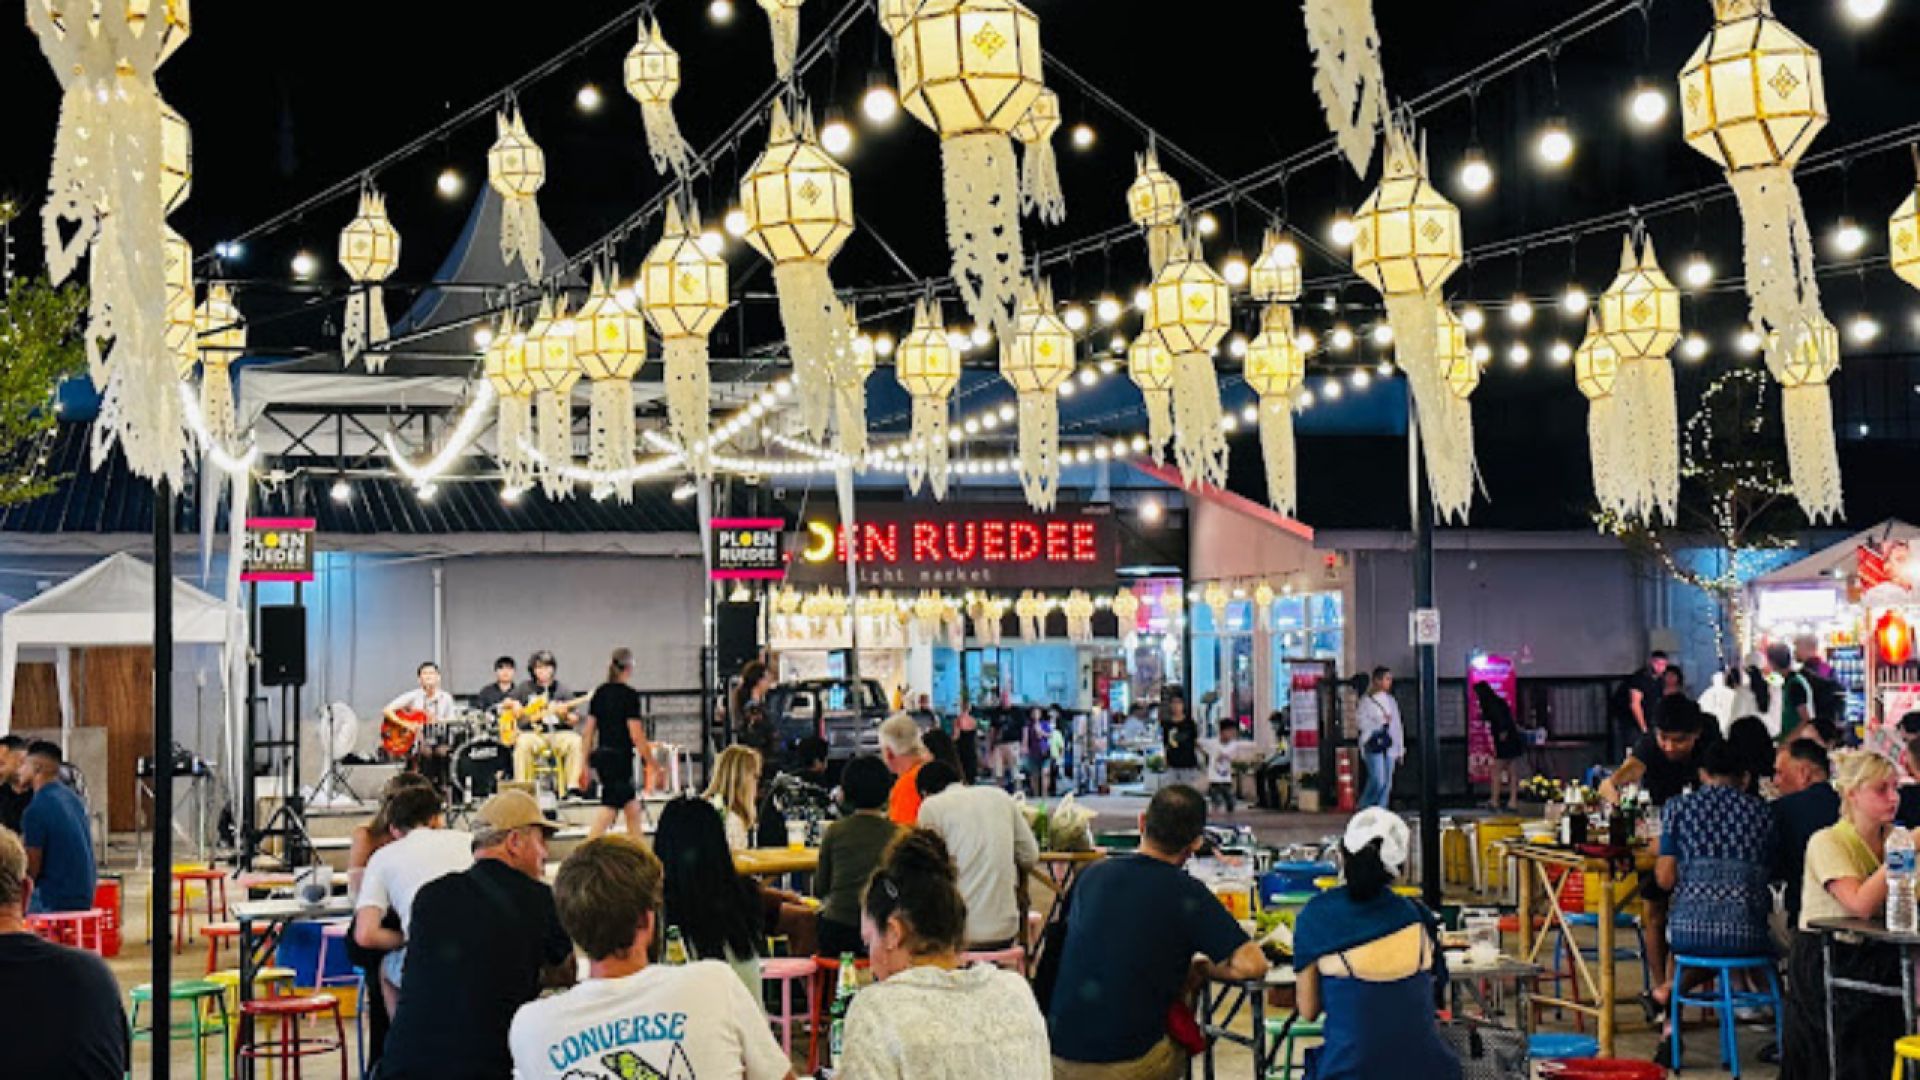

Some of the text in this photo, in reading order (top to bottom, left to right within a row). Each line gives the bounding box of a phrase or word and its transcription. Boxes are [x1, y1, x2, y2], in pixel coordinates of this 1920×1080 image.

[719, 531, 777, 547] PLOEN
[912, 520, 1097, 563] RUEDEE
[859, 567, 991, 583] ight market
[547, 1012, 688, 1071] CONVERSE
